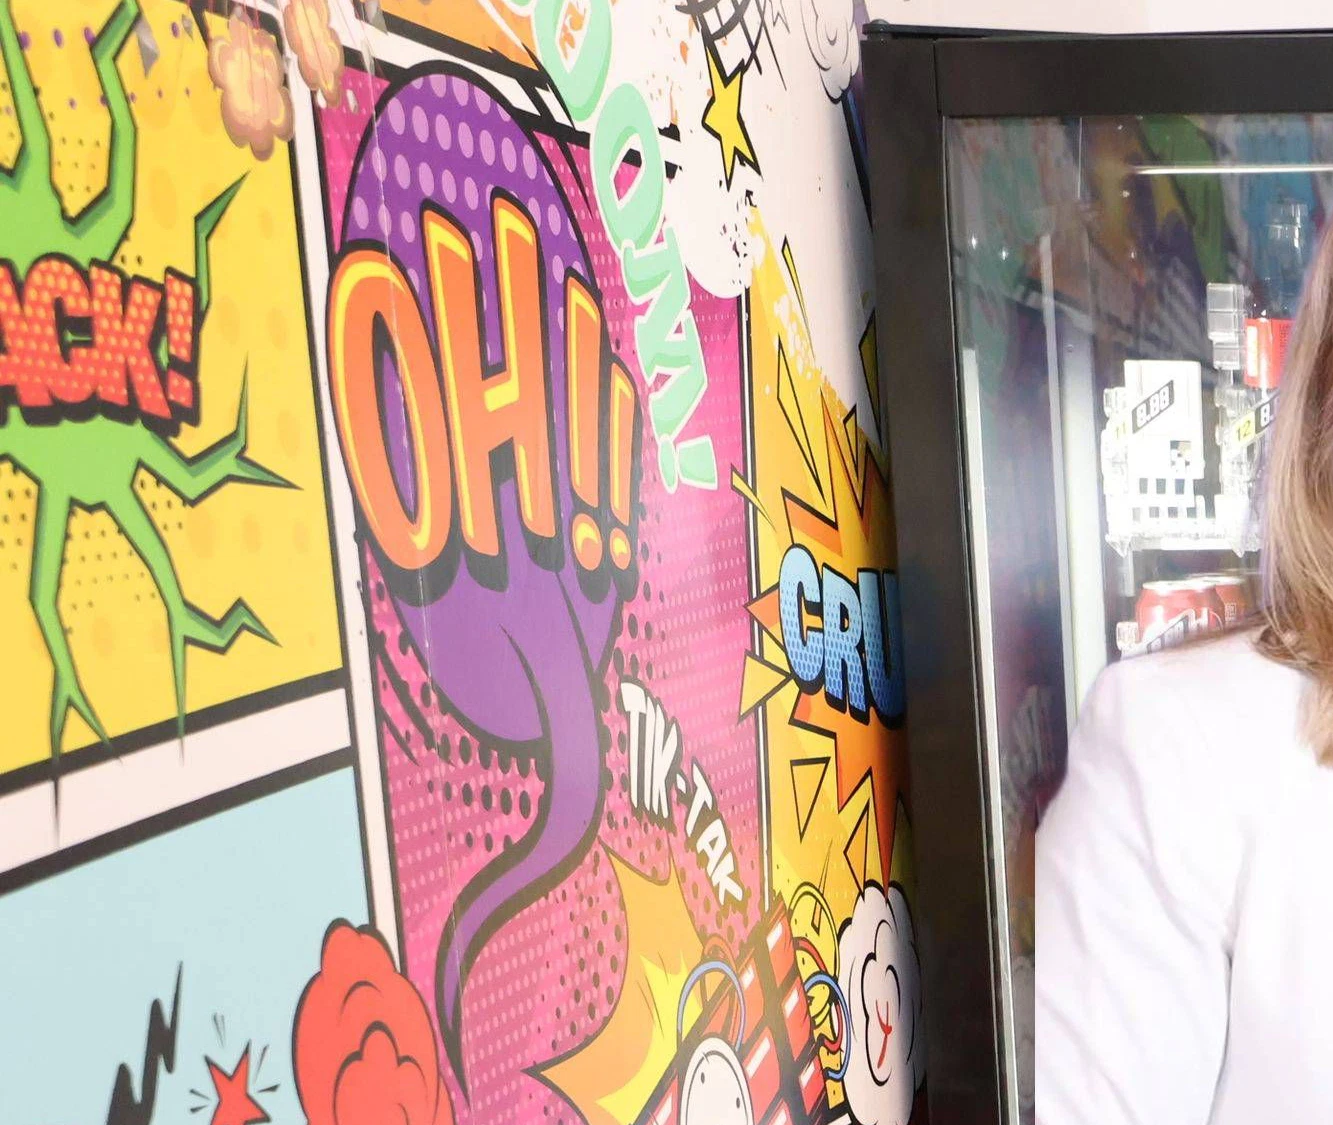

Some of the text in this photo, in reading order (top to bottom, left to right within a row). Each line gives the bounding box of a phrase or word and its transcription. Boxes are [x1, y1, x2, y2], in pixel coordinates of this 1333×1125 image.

[327, 195, 636, 575] OH!!
[1236, 418, 1252, 442] 12
[779, 543, 905, 730] CRU
[619, 680, 744, 906] TIK-TAK
